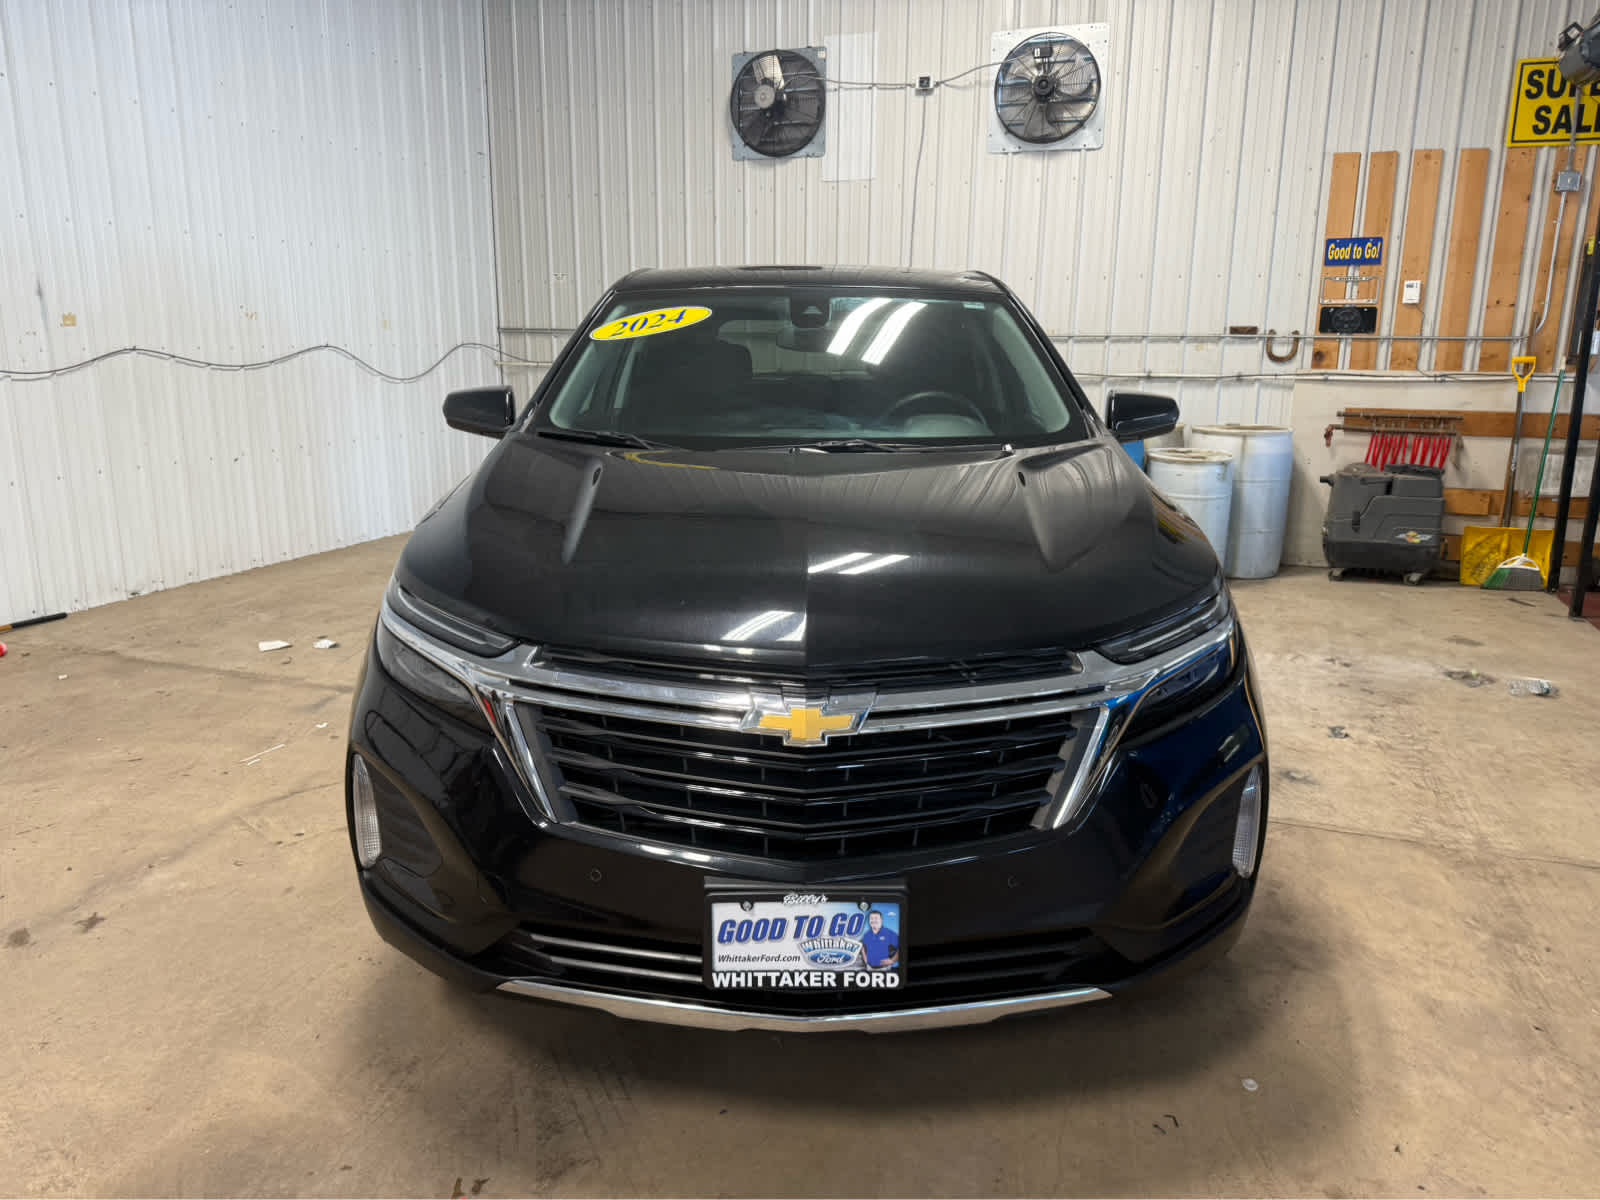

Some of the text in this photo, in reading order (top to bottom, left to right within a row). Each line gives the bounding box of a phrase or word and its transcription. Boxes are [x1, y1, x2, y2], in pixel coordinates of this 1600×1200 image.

[1328, 242, 1381, 260] Good to Go!
[609, 309, 687, 337] 2024
[717, 912, 866, 944] GOOD TO GO
[801, 938, 859, 953] Whittaker
[718, 953, 801, 964] WhittakerFord.com
[816, 953, 846, 965] Ford
[712, 971, 900, 989] WHITTAKER FORD
